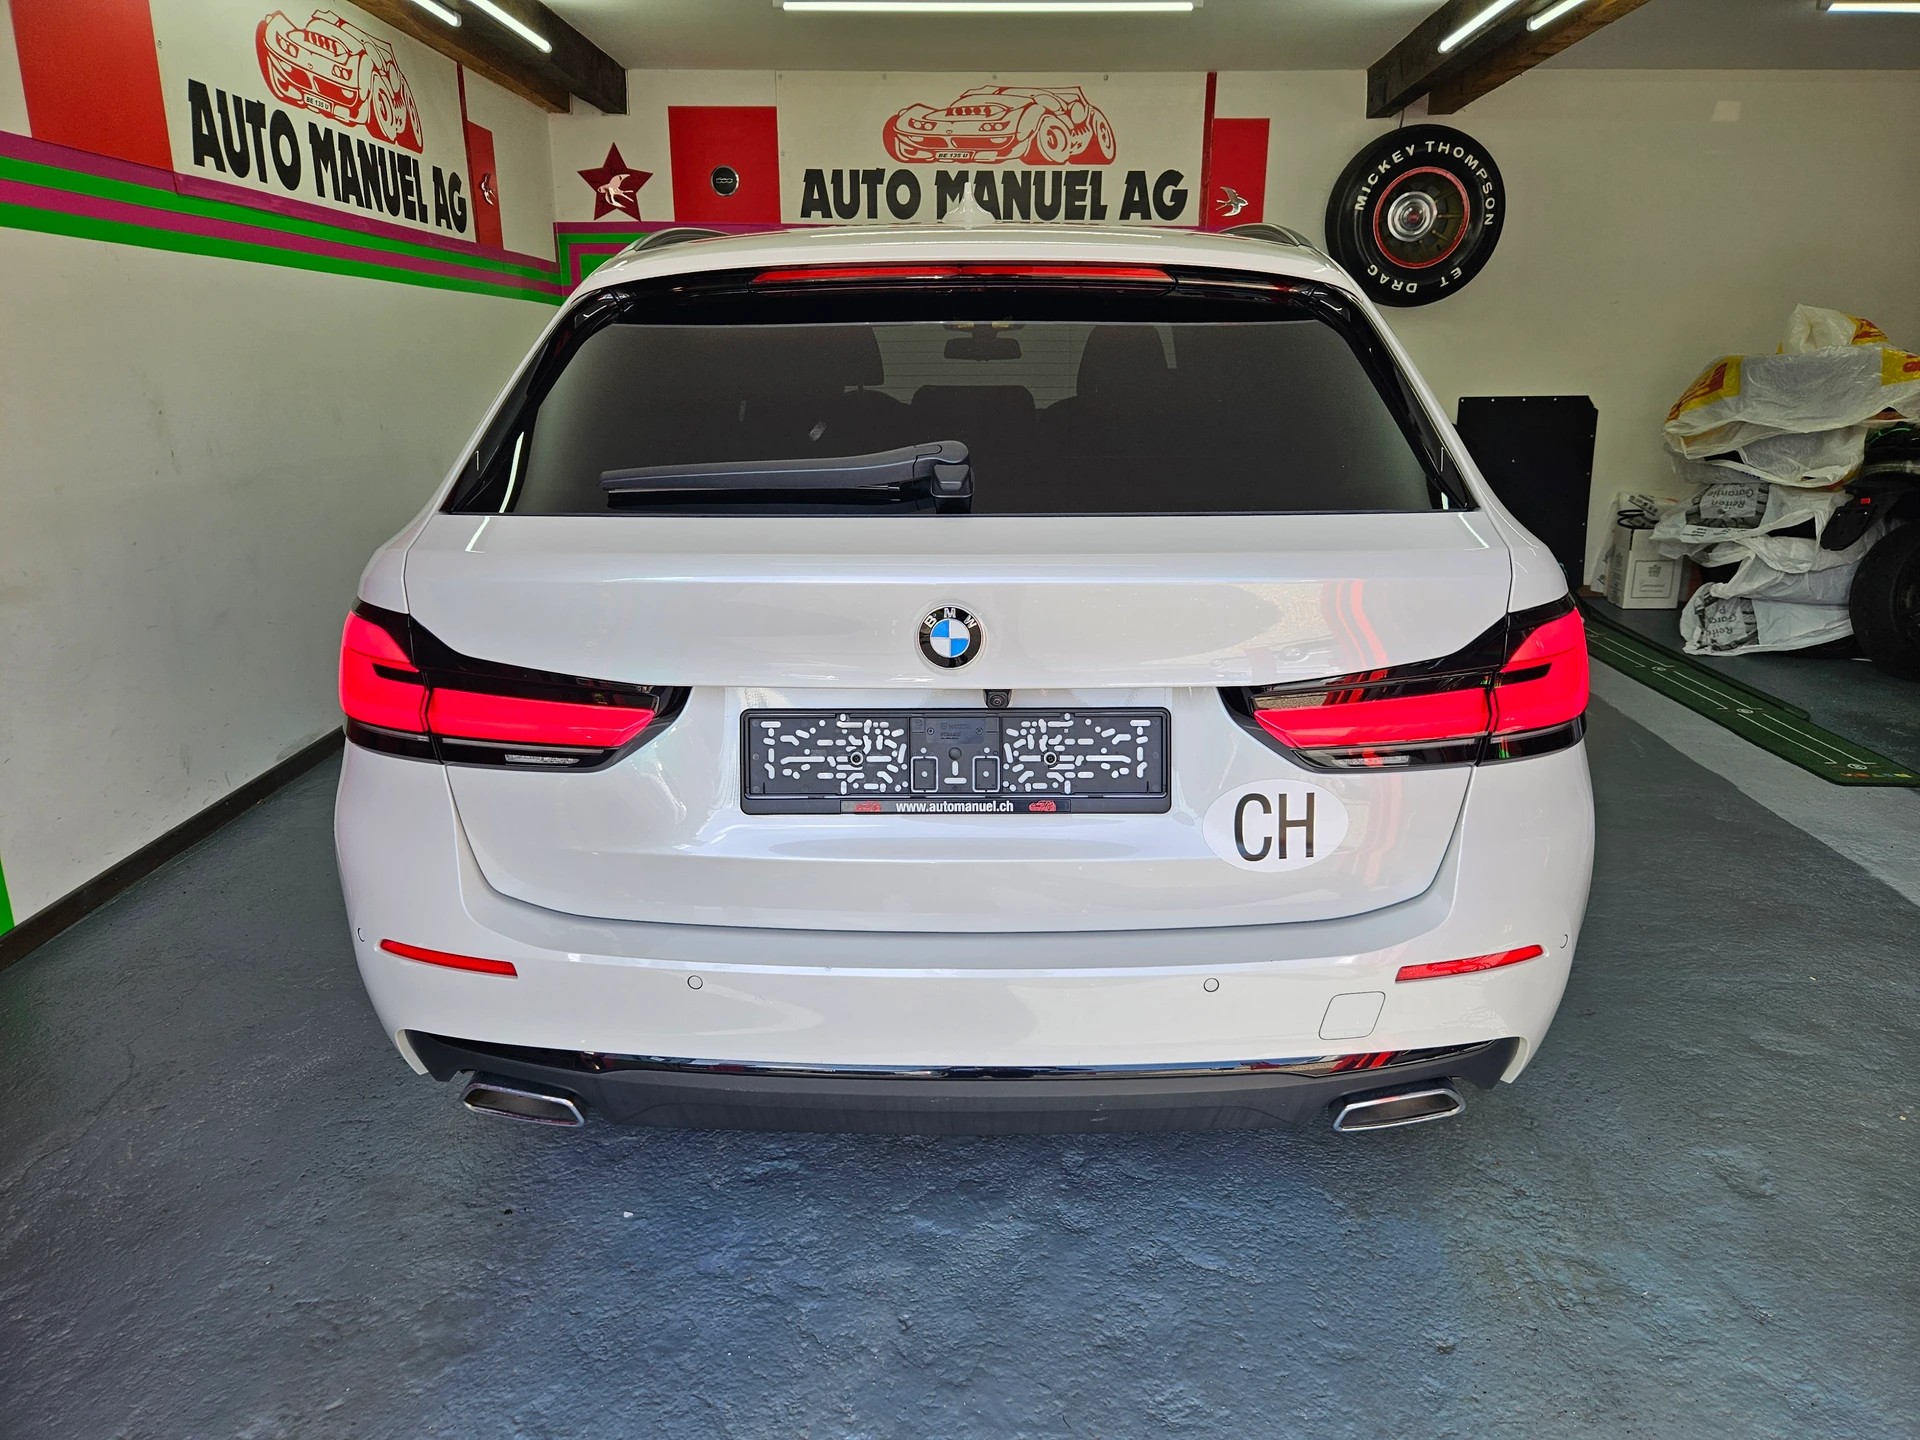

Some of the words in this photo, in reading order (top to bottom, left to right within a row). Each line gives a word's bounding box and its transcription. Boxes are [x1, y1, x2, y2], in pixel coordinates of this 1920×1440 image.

[188, 79, 300, 191] AUTO
[308, 122, 429, 224] MANUEL
[432, 165, 468, 234] AG
[800, 167, 921, 220] AUTO
[935, 169, 1107, 220] MANUEL
[1119, 169, 1188, 220] AG
[1354, 144, 1415, 211] MICKEY
[1425, 140, 1496, 226] THOMPSON
[1367, 264, 1418, 293] DRAG
[1439, 266, 1462, 288] ET
[923, 607, 977, 629] BMW
[896, 800, 1014, 812] www.automanuel.ch
[1234, 792, 1315, 861] CH
